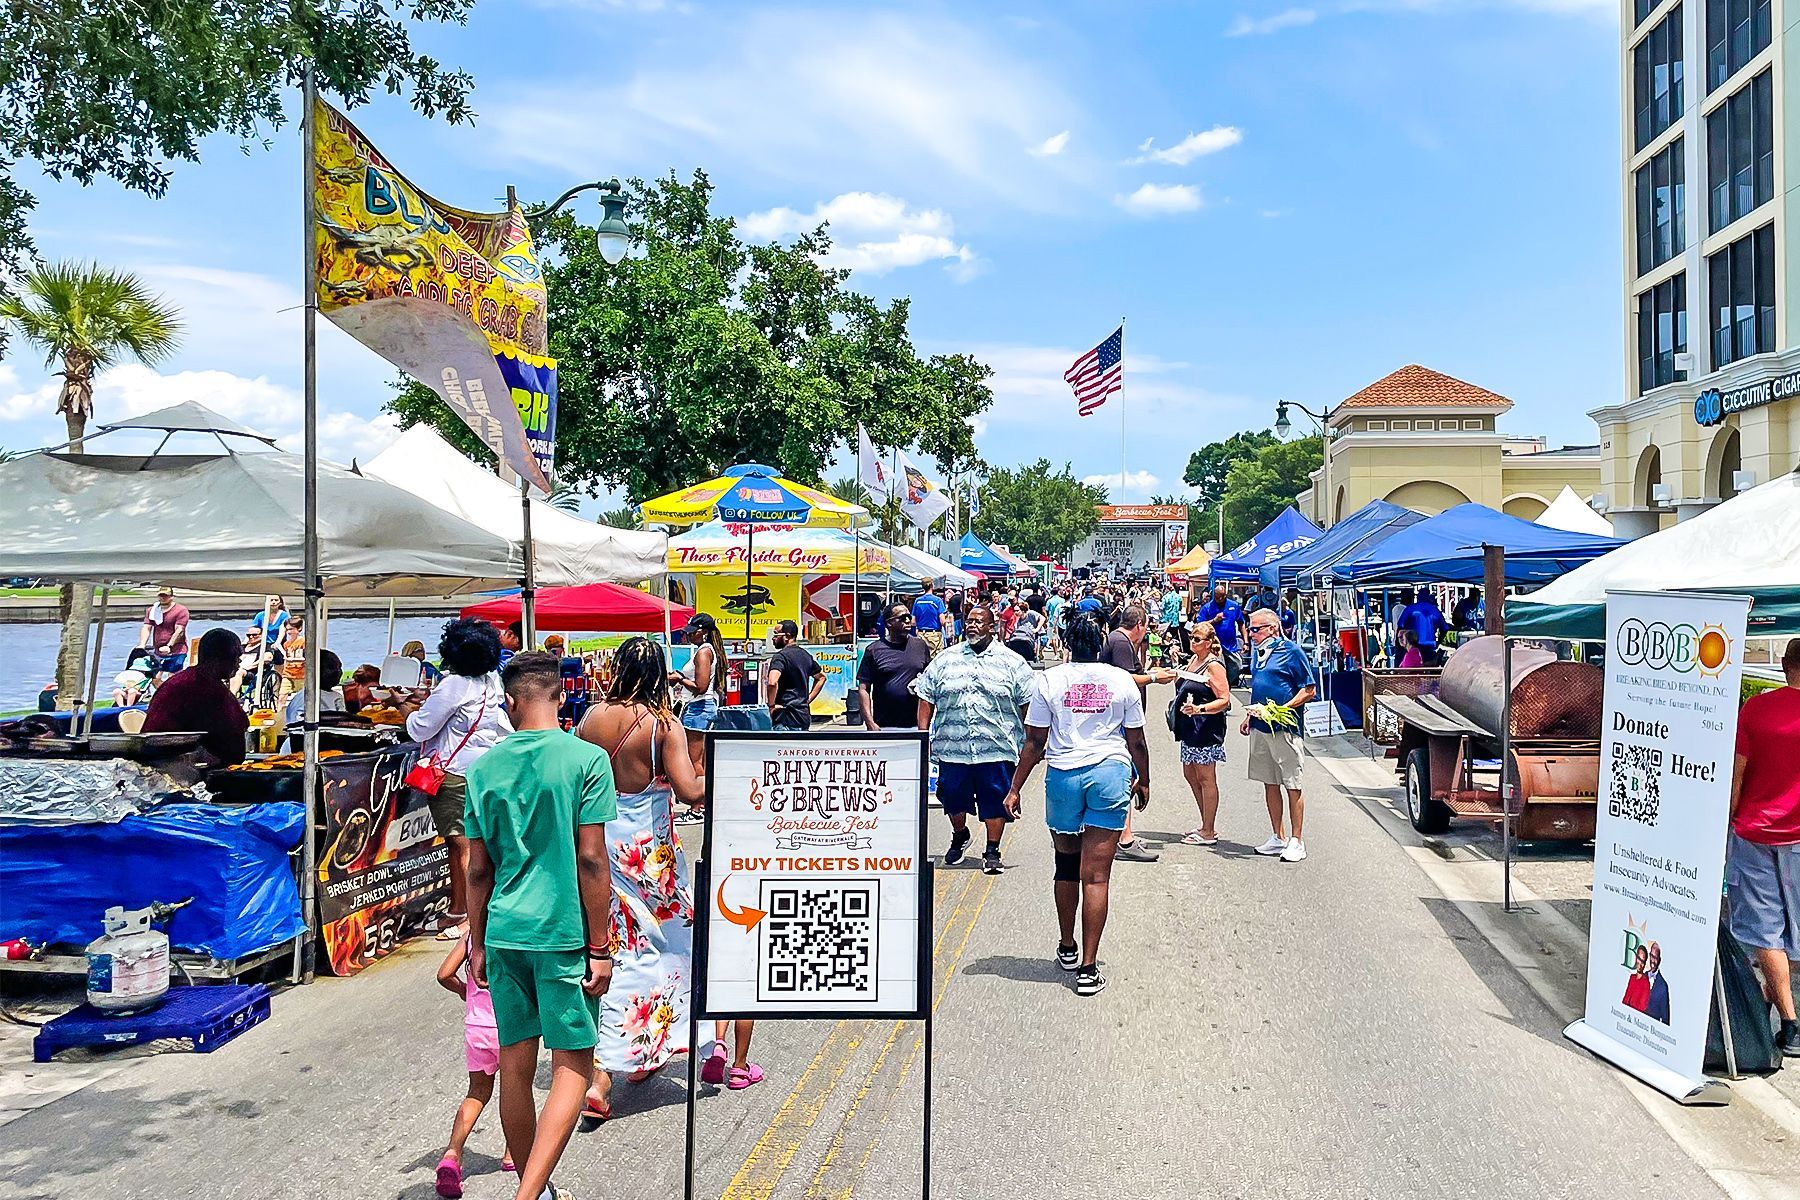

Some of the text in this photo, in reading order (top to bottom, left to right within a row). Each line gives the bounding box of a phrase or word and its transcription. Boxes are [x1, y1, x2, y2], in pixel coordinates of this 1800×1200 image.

[1722, 383, 1771, 412] EXECUTIVE
[676, 547, 720, 564] Those
[788, 547, 828, 569] Guys
[1094, 539, 1134, 549] RHYTHM
[1103, 547, 1131, 558] BREWS
[1613, 711, 1670, 740] Donate
[1701, 719, 1725, 732] 501c3
[777, 749, 878, 757] SANFORD RIVERWALK
[762, 760, 888, 788] RHYTHM
[1670, 753, 1717, 783] Here!
[769, 785, 878, 819] & BREWS
[766, 815, 879, 834] Barbecue Fest
[730, 857, 912, 871] BUY TICKETS NOW
[1612, 842, 1699, 881] Unsheltered & Food
[327, 874, 366, 898] BRISKET
[366, 867, 393, 884] BOWL
[349, 887, 386, 910] JERKED
[386, 879, 410, 896] PORK
[410, 870, 434, 887] BOWL
[1609, 860, 1699, 902] Insecurity Advocates.
